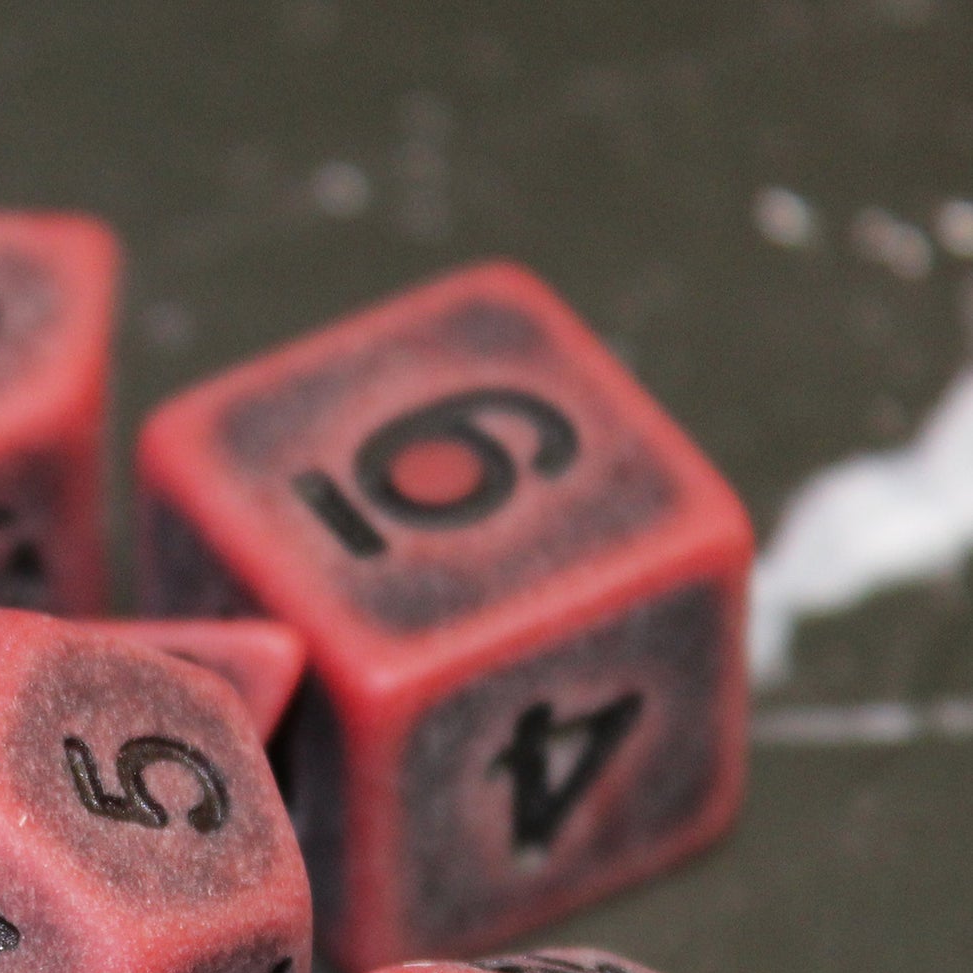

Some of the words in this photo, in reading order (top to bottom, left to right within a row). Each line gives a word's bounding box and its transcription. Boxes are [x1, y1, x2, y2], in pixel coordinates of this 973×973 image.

[292, 386, 582, 558] 6
[63, 734, 230, 834] 5
[485, 692, 643, 868] 4
